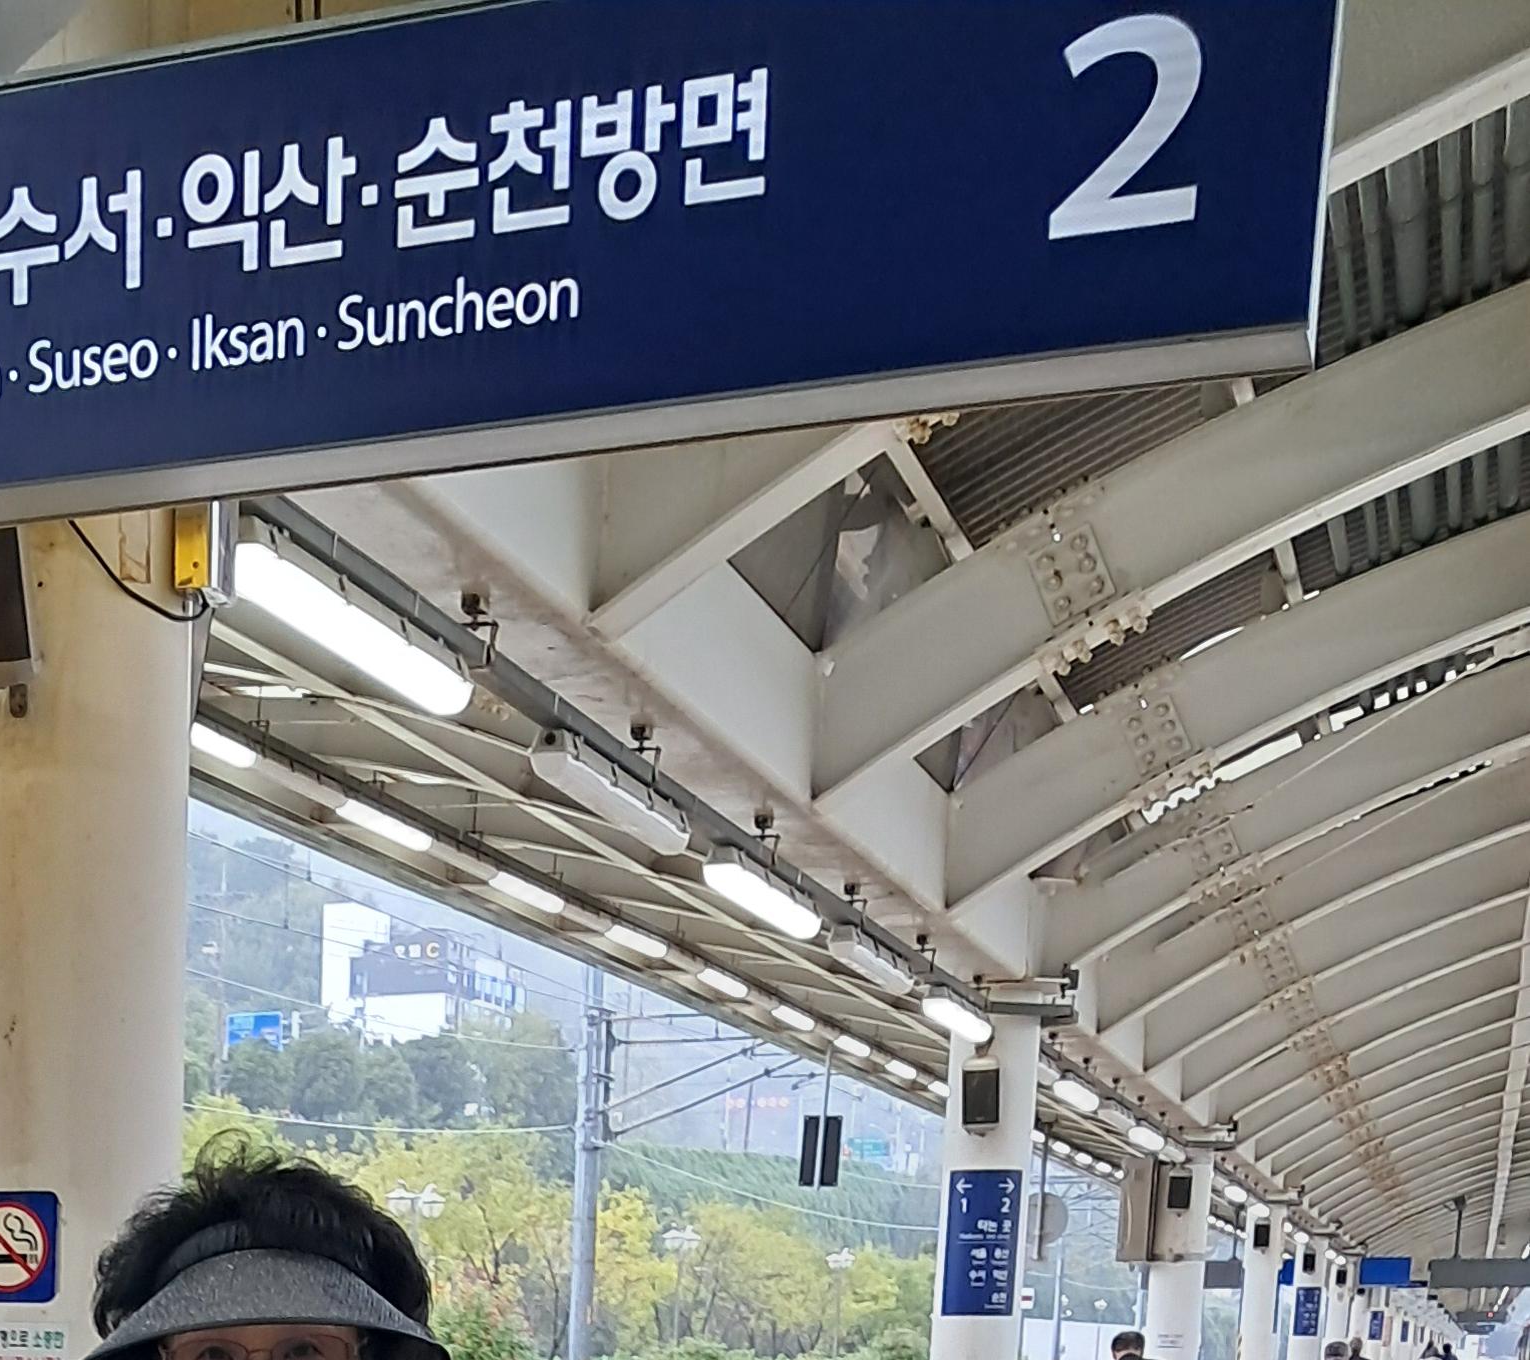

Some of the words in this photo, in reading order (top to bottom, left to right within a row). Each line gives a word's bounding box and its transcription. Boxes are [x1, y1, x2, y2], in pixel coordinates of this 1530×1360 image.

[1047, 13, 1203, 241] 2
[27, 338, 160, 394] Suseo
[190, 312, 305, 372] Iksan
[336, 276, 580, 351] Suncheon
[960, 1197, 968, 1214] 1
[1000, 1197, 1012, 1214] 2
